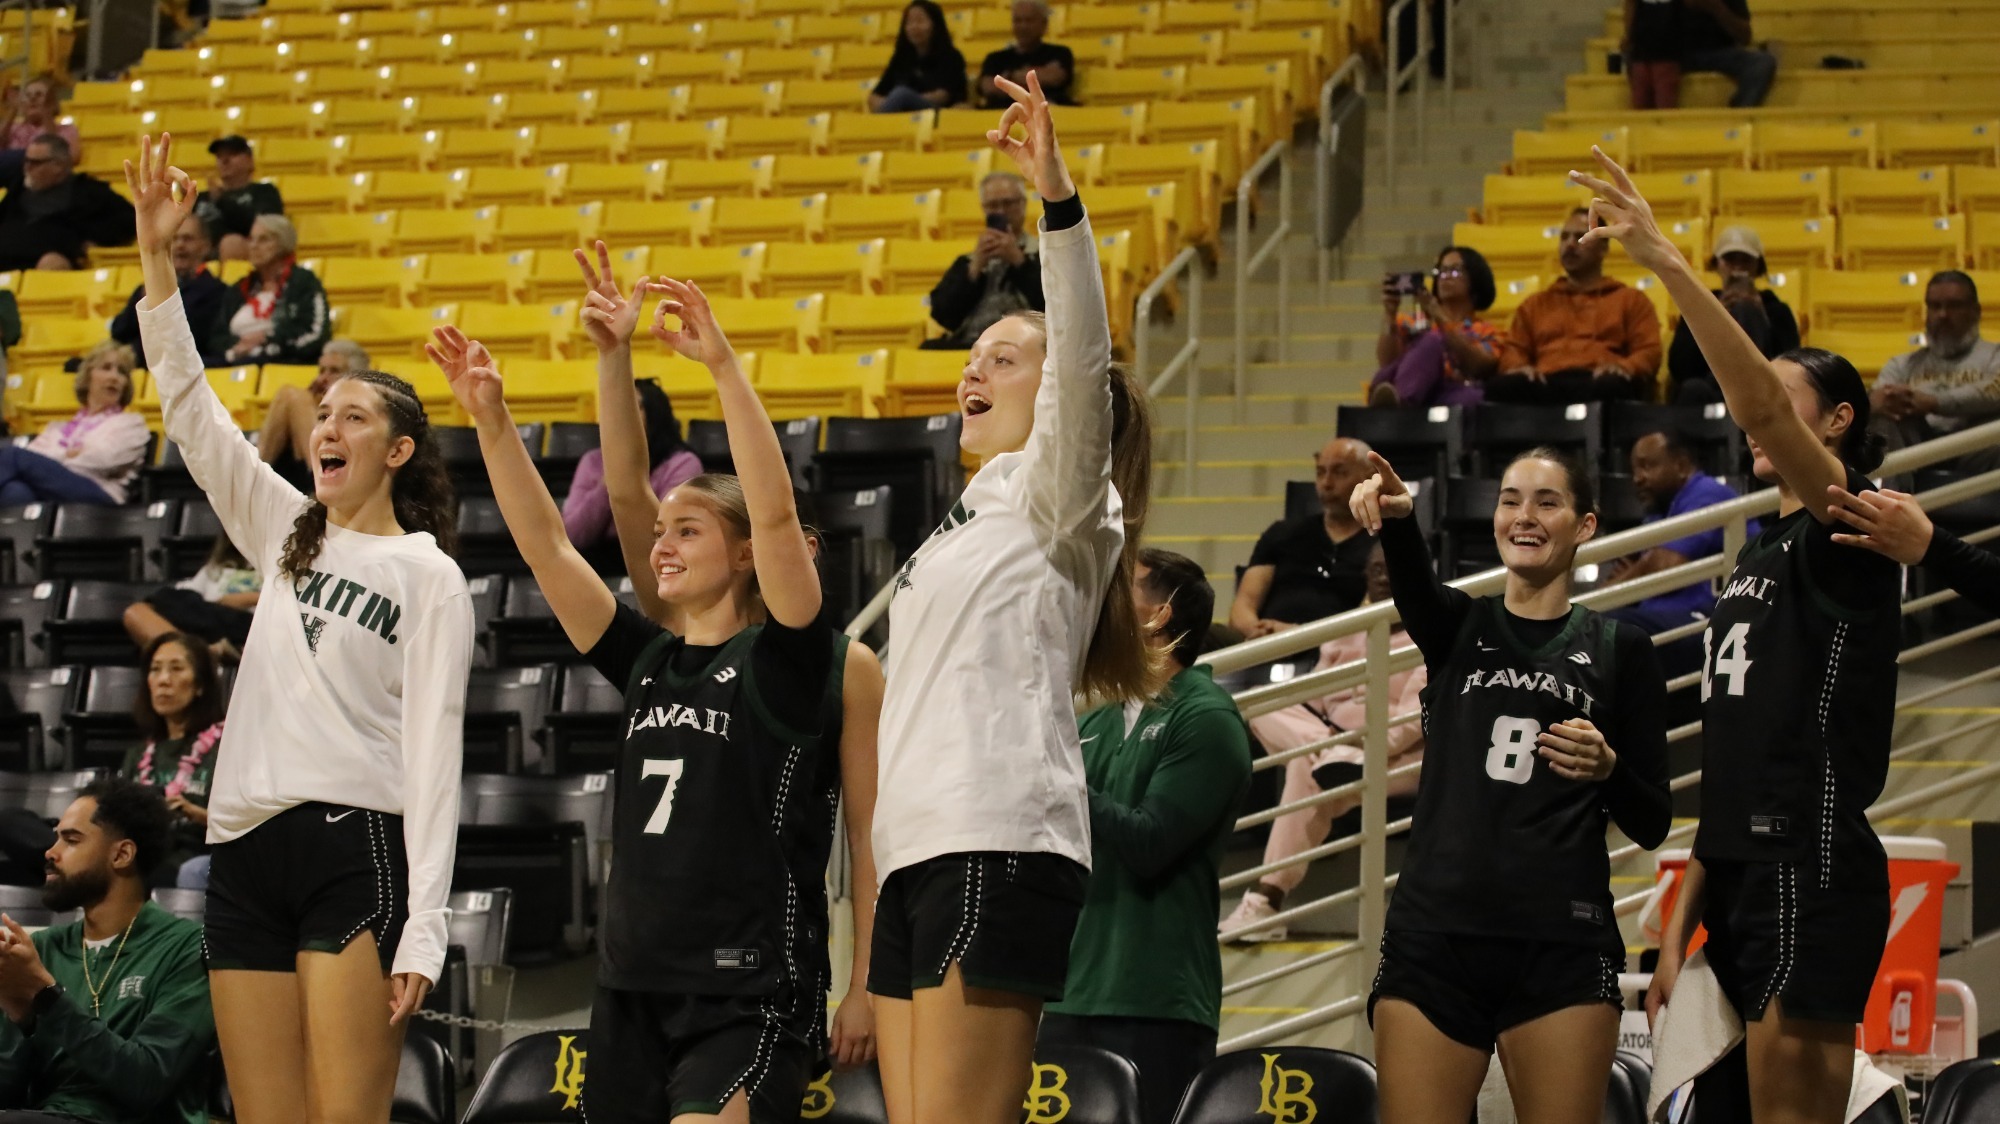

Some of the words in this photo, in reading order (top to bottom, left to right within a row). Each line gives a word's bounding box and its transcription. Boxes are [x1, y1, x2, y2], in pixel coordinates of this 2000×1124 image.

[324, 578, 367, 617] IT
[357, 592, 401, 645] IN.
[1701, 622, 1753, 703] 14
[1485, 715, 1541, 785] 8
[641, 758, 684, 834] 7
[745, 954, 754, 963] M
